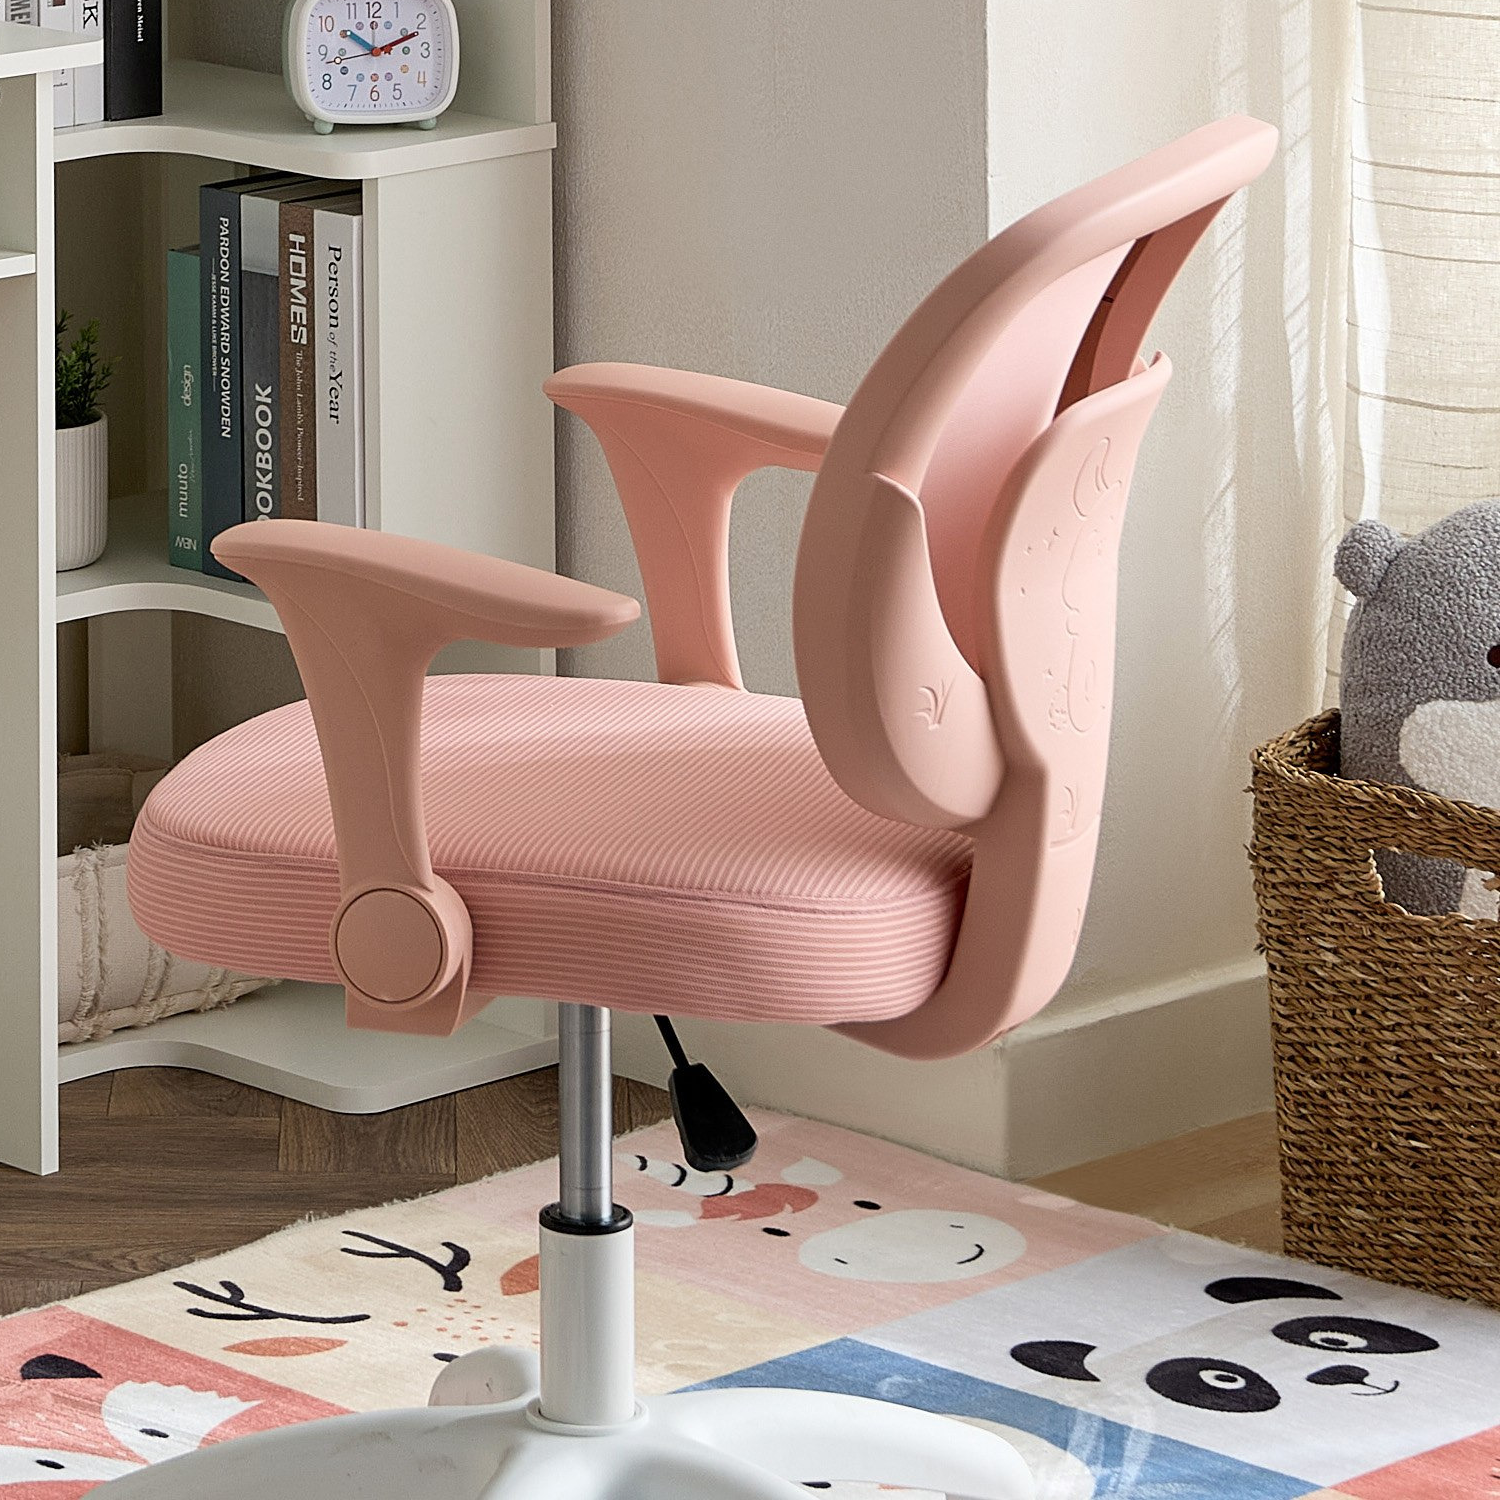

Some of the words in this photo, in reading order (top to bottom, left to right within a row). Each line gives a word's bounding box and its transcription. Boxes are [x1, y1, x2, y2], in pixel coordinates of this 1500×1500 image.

[346, 3, 357, 19] 11
[365, 1, 382, 19] 12
[394, 2, 399, 18] 1
[319, 16, 334, 32] 10
[416, 13, 426, 29] 2
[318, 45, 328, 61] 9
[420, 42, 431, 58] 3
[322, 73, 332, 90] 8
[417, 71, 427, 87] 4
[347, 85, 357, 101] 7
[369, 85, 380, 101] 6
[392, 83, 402, 100] 5
[219, 217, 230, 282] PARDON
[289, 233, 307, 345] HOMES
[328, 245, 342, 328] Person
[219, 285, 230, 354] EDWARD
[328, 332, 338, 348] of
[329, 350, 339, 372] the
[181, 365, 194, 407] design
[220, 356, 231, 438] SNOWDEN
[329, 371, 343, 424] Year
[255, 384, 273, 521] OKBOOK
[178, 463, 188, 518] muuto
